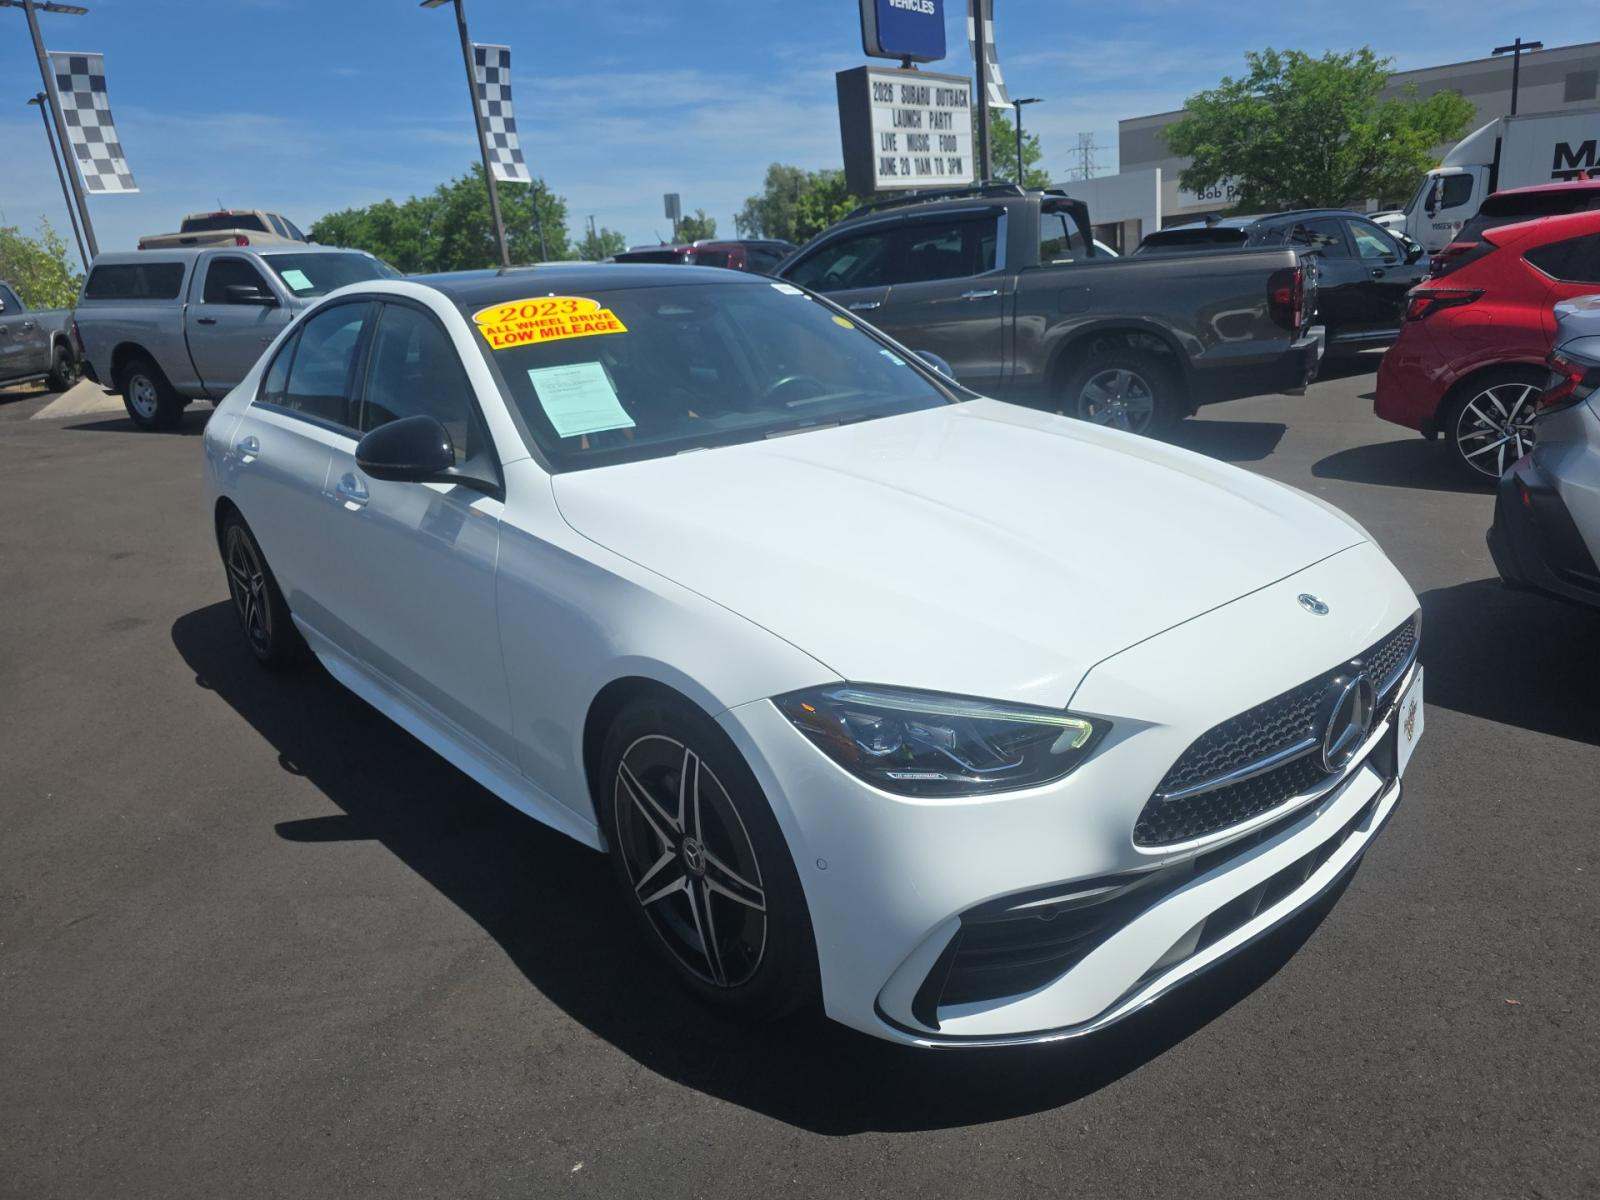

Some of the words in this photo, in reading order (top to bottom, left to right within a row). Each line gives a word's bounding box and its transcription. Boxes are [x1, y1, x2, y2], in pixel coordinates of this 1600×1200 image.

[873, 83, 894, 103] 2026
[901, 85, 930, 105] SUBARU
[936, 88, 968, 108] OUTBACK
[892, 109, 922, 128] LAUNCH
[929, 111, 953, 130] PARTY
[880, 132, 898, 151] LIVE
[906, 133, 930, 152] MUSIC
[939, 135, 957, 153] FOOD
[1553, 139, 1600, 169] M
[879, 157, 898, 175] JUNE
[900, 157, 911, 175] 20
[934, 157, 944, 175] TO
[947, 157, 963, 175] 3PM
[500, 300, 578, 323] 2023
[486, 324, 512, 336] ALL
[515, 318, 563, 329] WHEEL
[569, 312, 611, 323] DRIVE
[493, 331, 534, 346] LOW
[540, 319, 619, 338] MILEAGE
